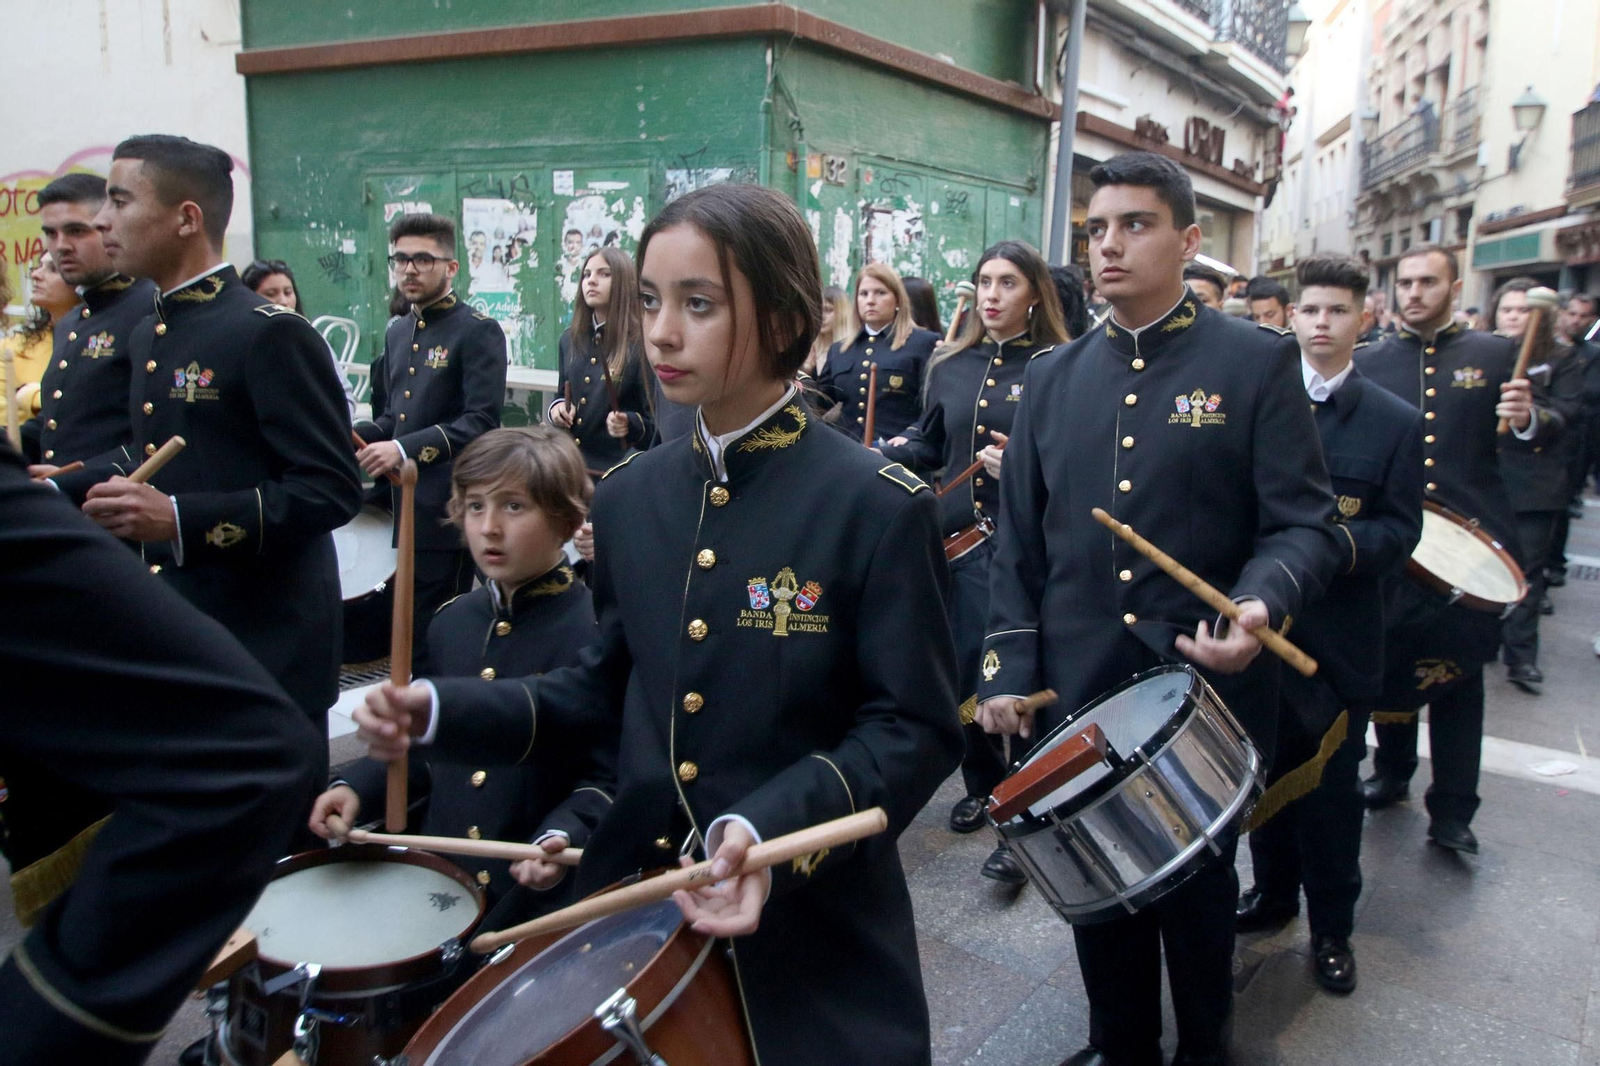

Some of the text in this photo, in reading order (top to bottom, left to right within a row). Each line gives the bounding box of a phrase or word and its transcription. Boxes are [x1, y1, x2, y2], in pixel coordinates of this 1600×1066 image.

[827, 155, 847, 183] 32
[740, 609, 773, 619] BANDA
[736, 618, 773, 628] LOS IRIS
[788, 623, 827, 632] ALMERIA
